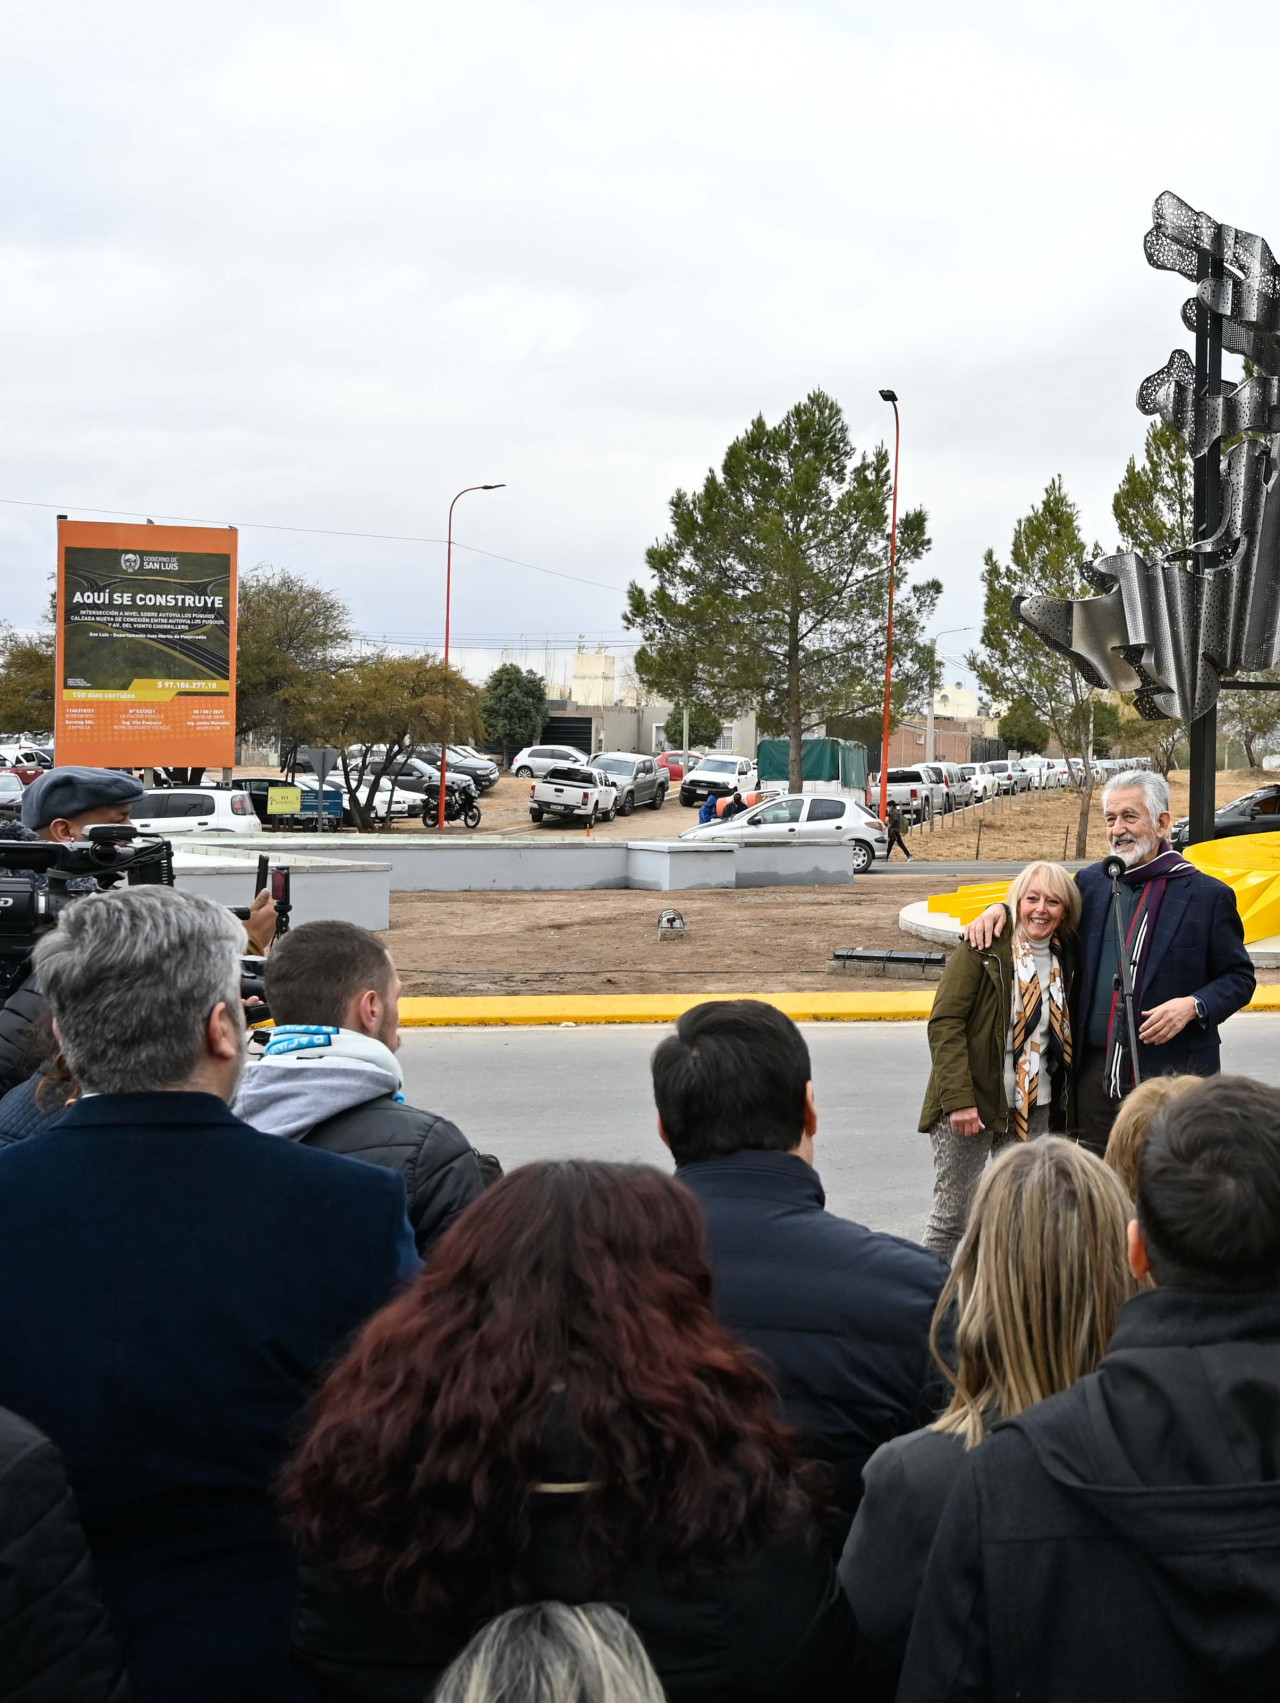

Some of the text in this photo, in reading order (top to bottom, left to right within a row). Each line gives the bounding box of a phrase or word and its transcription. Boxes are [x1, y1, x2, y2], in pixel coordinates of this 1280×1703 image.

[143, 562, 179, 571] SAN LUIS
[73, 589, 223, 608] AQUÍ SE CONSTRUYE
[157, 681, 163, 689] $
